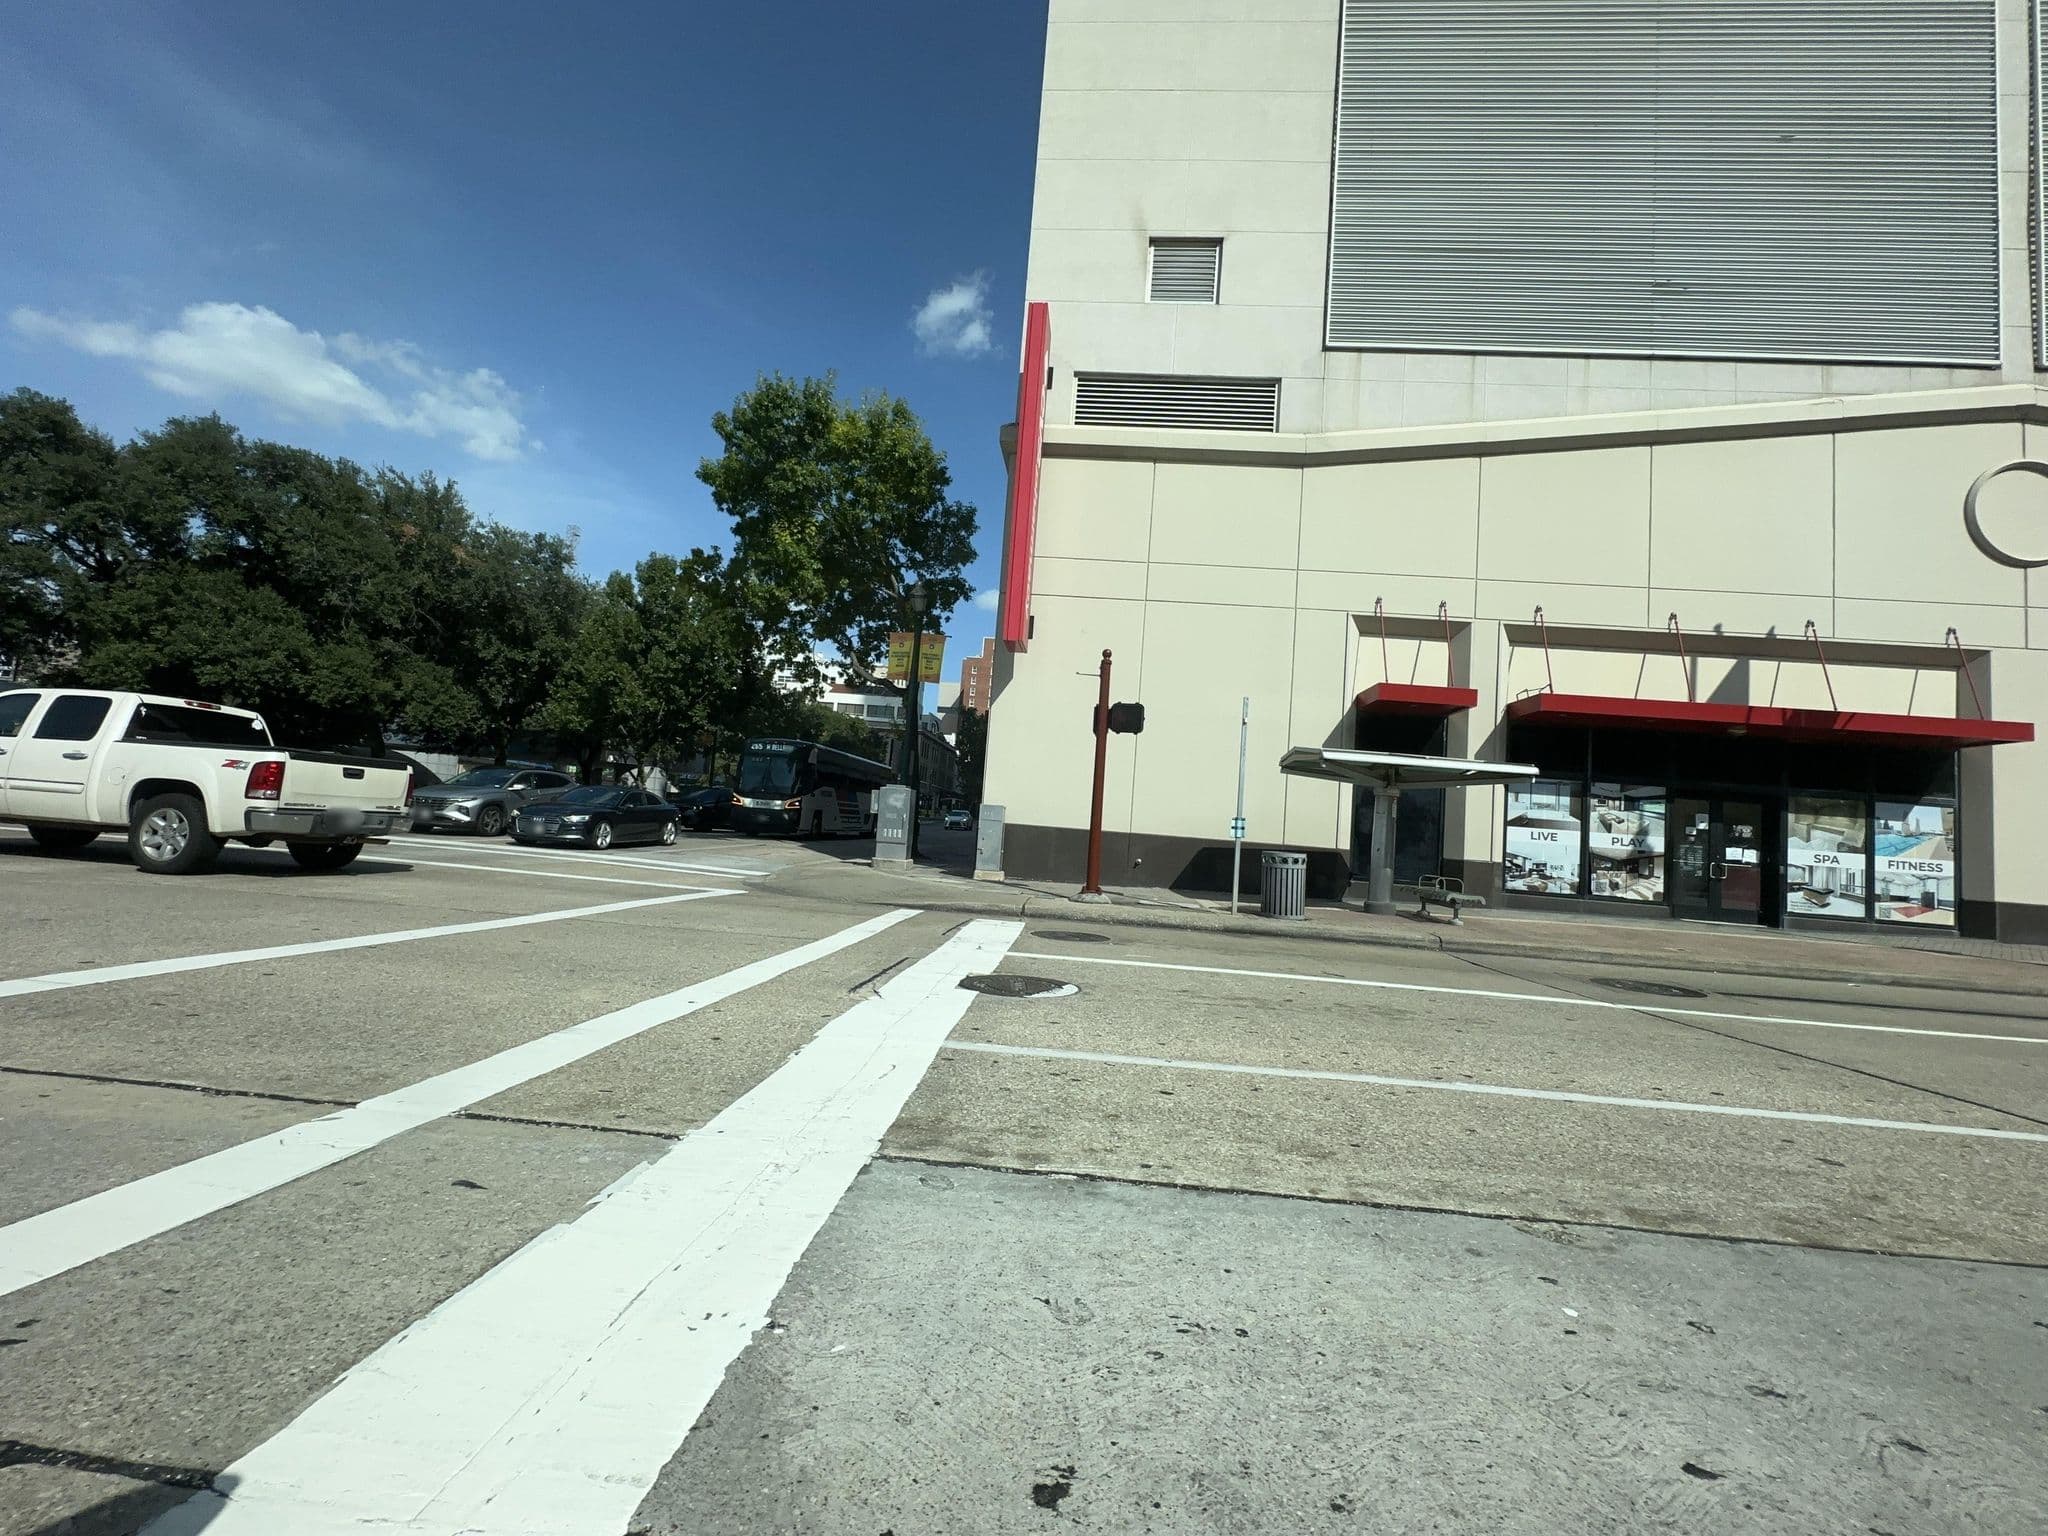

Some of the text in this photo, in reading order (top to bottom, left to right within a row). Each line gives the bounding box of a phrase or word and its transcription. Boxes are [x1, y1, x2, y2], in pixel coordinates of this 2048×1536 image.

[1530, 831, 1558, 842] LIVE
[1611, 837, 1645, 848] PLAY
[1813, 854, 1840, 865] SPA
[1887, 860, 1944, 873] FITNESS
